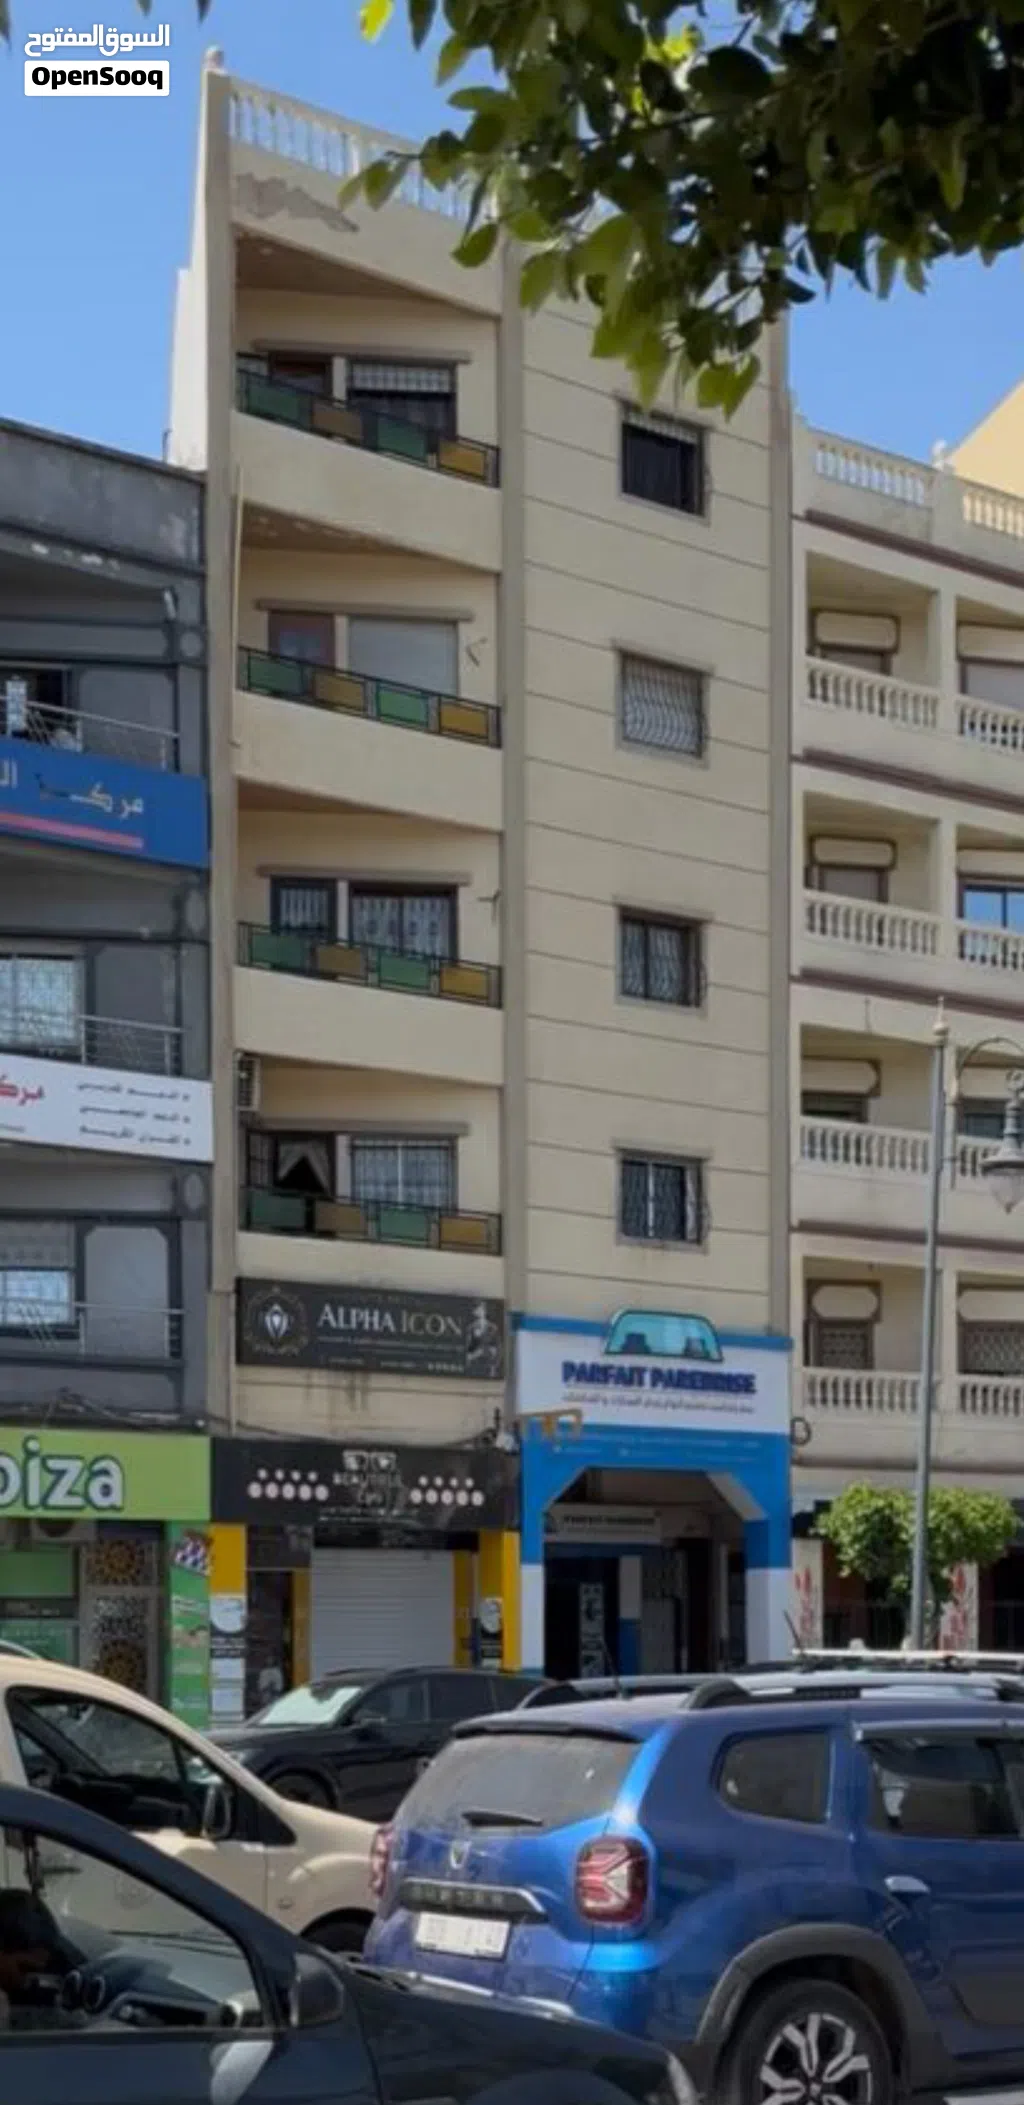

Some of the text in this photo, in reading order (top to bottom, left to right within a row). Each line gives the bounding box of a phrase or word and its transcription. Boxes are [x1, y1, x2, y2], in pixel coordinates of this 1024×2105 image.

[316, 1303, 463, 1337] ALPHA ICON
[562, 1360, 647, 1388] PARFAIT
